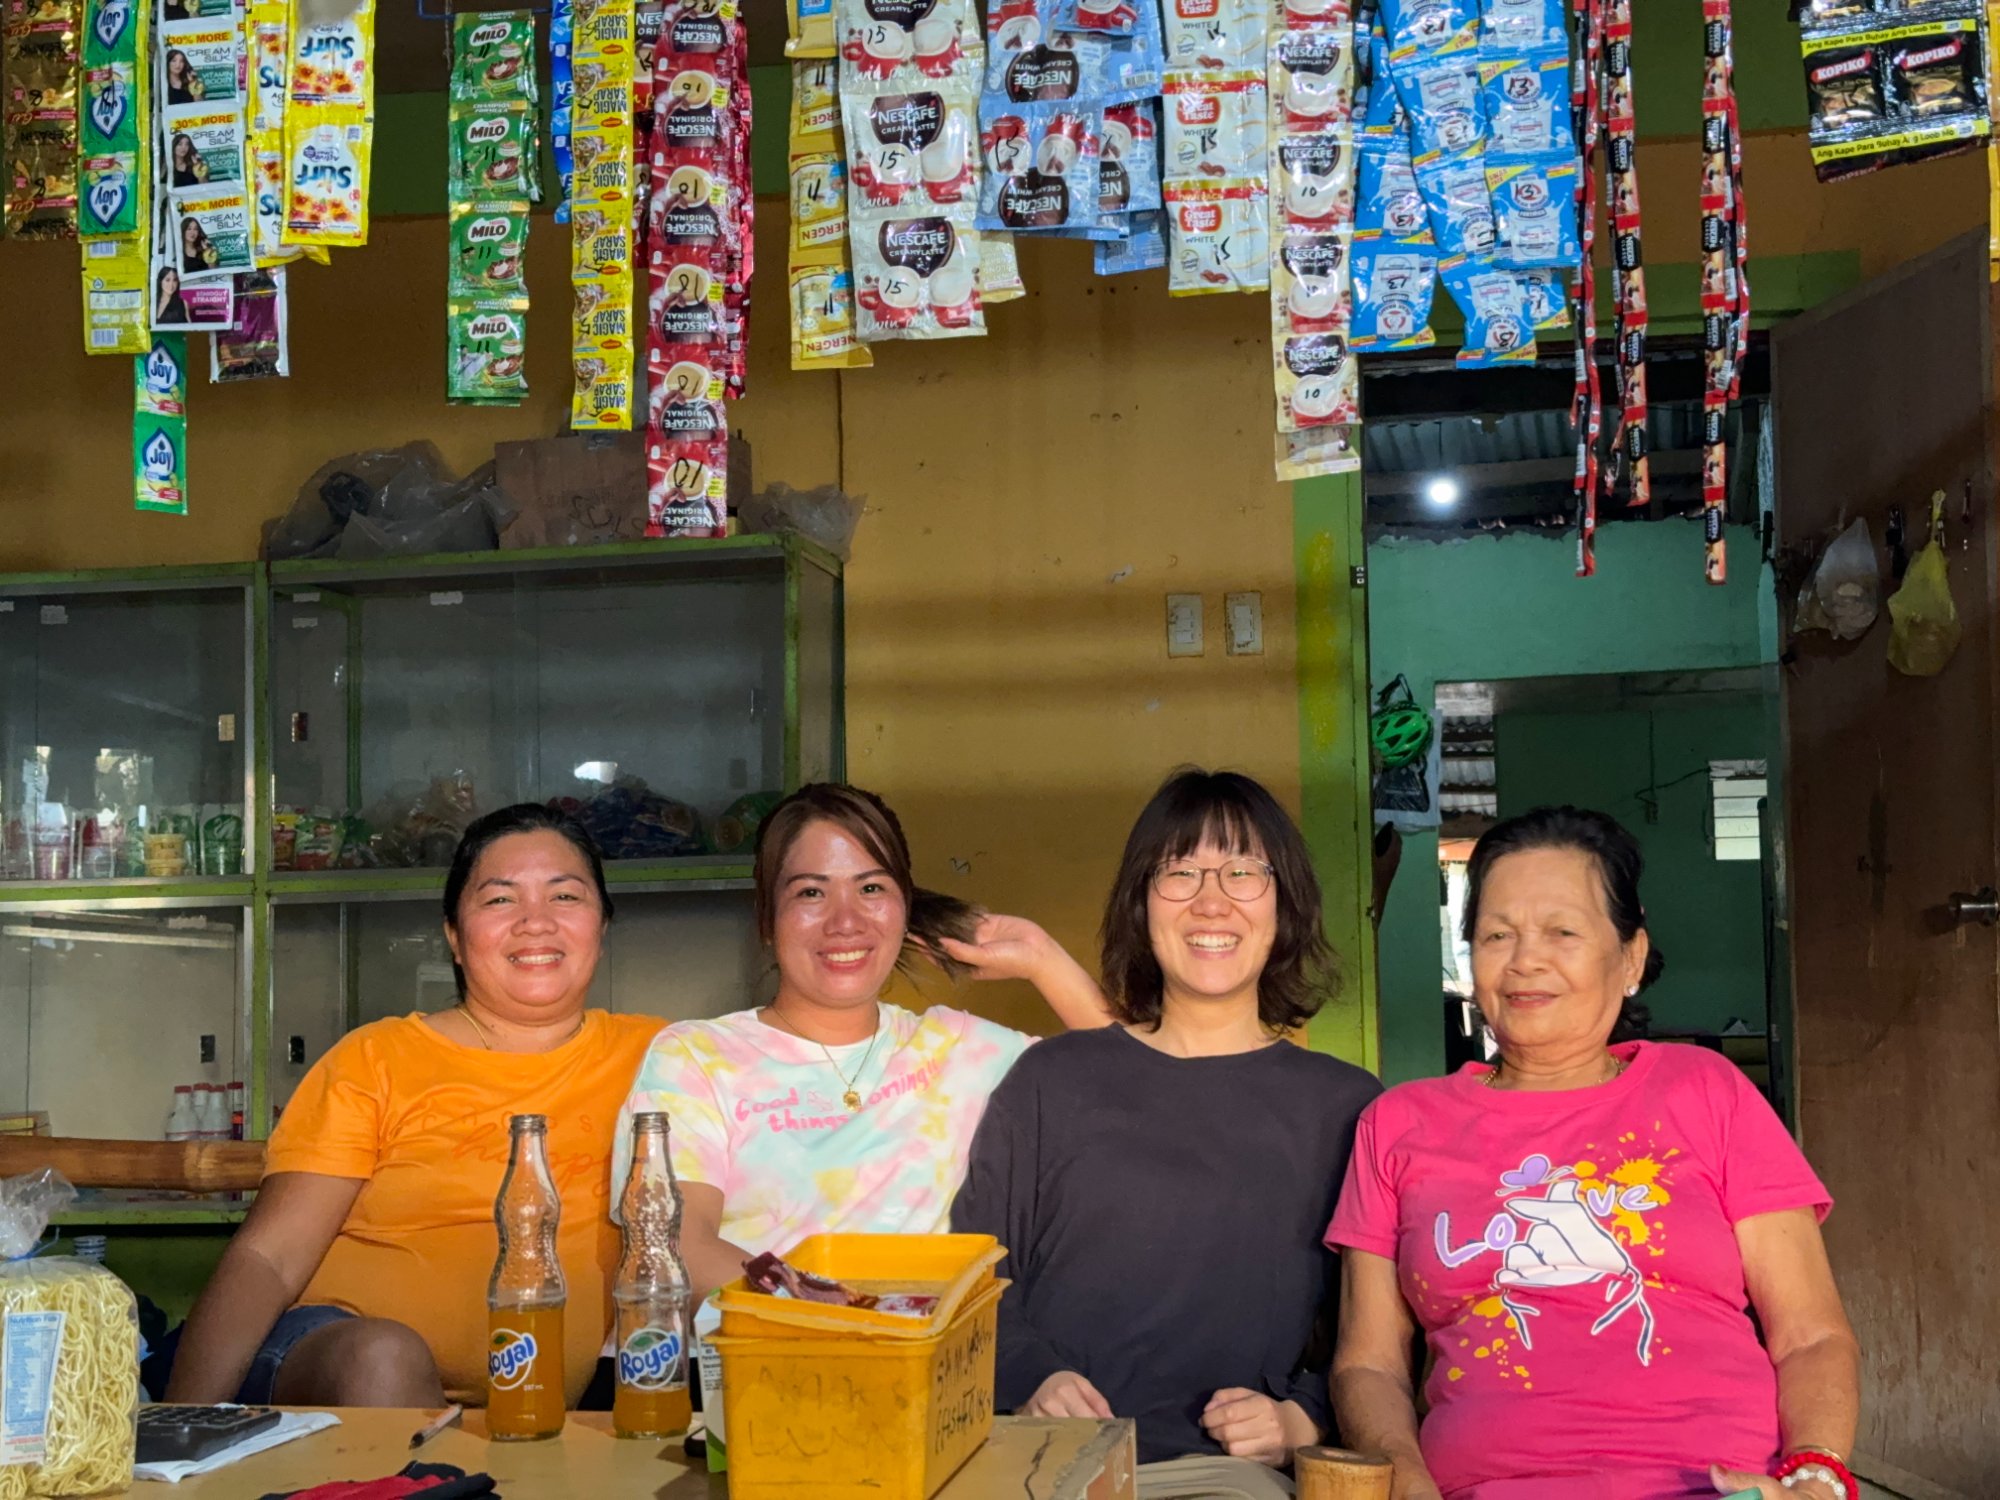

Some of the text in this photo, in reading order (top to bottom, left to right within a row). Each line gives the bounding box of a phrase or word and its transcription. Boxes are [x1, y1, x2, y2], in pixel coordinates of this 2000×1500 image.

[595, 15, 628, 27] SARAP
[1182, 21, 1213, 29] WHITE
[196, 32, 229, 43] MORE
[473, 29, 507, 43] MILO
[595, 27, 628, 40] MAGIC
[867, 25, 887, 45] 15
[299, 36, 355, 59] Surf
[1806, 42, 1822, 50] Ang
[1824, 38, 1844, 46] Kape
[187, 47, 231, 57] CREAM
[204, 54, 230, 63] SILK
[1905, 44, 1956, 68] KOPIKO
[1816, 57, 1866, 81] KOPIKO
[594, 88, 626, 100] SARAP
[594, 100, 627, 113] MAGIC
[175, 115, 234, 129] 30% MORE
[192, 129, 235, 140] CREAM
[470, 126, 505, 139] MILO
[208, 136, 234, 146] SILK
[1817, 150, 1834, 159] Ang
[1835, 146, 1855, 156] Kape
[1857, 143, 1875, 151] Para
[1902, 136, 1919, 144] Ag
[1920, 131, 1941, 141] Loob
[1942, 128, 1955, 137] Mo
[206, 152, 238, 161] VITAMIN
[879, 150, 905, 170] 15
[593, 161, 626, 173] SARAP
[294, 163, 352, 189] Surf
[593, 174, 626, 188] MAGIC
[1301, 186, 1318, 197] 10
[208, 197, 241, 210] MORE
[199, 212, 243, 225] CREAM
[1184, 209, 1216, 220] Great
[216, 220, 243, 230] SILK
[1185, 218, 1216, 229] Taste
[471, 225, 507, 239] MILO
[592, 236, 626, 248] SARAP
[1185, 236, 1216, 244] WHITE
[592, 248, 626, 261] MAGIC
[884, 279, 910, 295] 15
[593, 309, 626, 322] SARAP
[665, 312, 710, 320] ORIGINAL
[472, 322, 507, 336] MILO
[592, 323, 626, 336] MAGIC
[150, 360, 173, 384] Joy
[593, 383, 626, 396] SARAP
[1304, 388, 1321, 399] 10
[593, 396, 626, 409] MAGIC
[665, 409, 709, 417] ORIGINAL
[150, 448, 172, 471] Joy
[665, 507, 709, 515] ORIGINAL
[734, 1087, 799, 1122] Good
[768, 1109, 850, 1133] things
[10, 1316, 41, 1324] Nutrition
[619, 1331, 682, 1383] Royal
